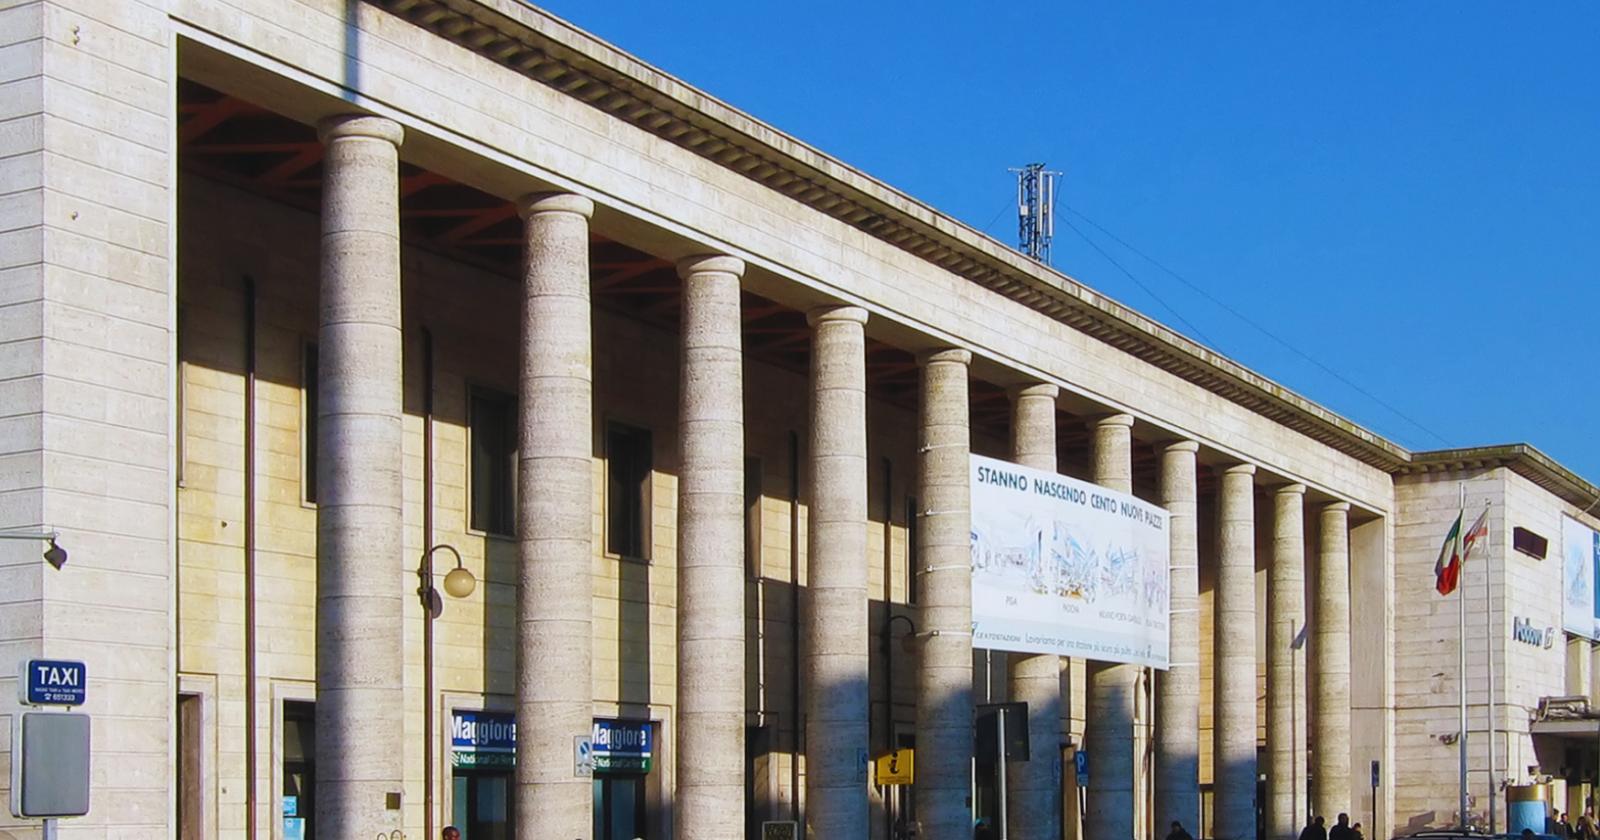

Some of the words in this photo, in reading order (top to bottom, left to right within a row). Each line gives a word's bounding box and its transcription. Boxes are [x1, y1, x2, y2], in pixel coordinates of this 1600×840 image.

[978, 466, 1028, 491] STANNO
[1034, 478, 1086, 505] NASCENDO
[1091, 493, 1117, 514] CENTO
[38, 666, 78, 686] TAXI
[451, 715, 516, 745] Maggiore
[592, 723, 646, 750] Maggiore
